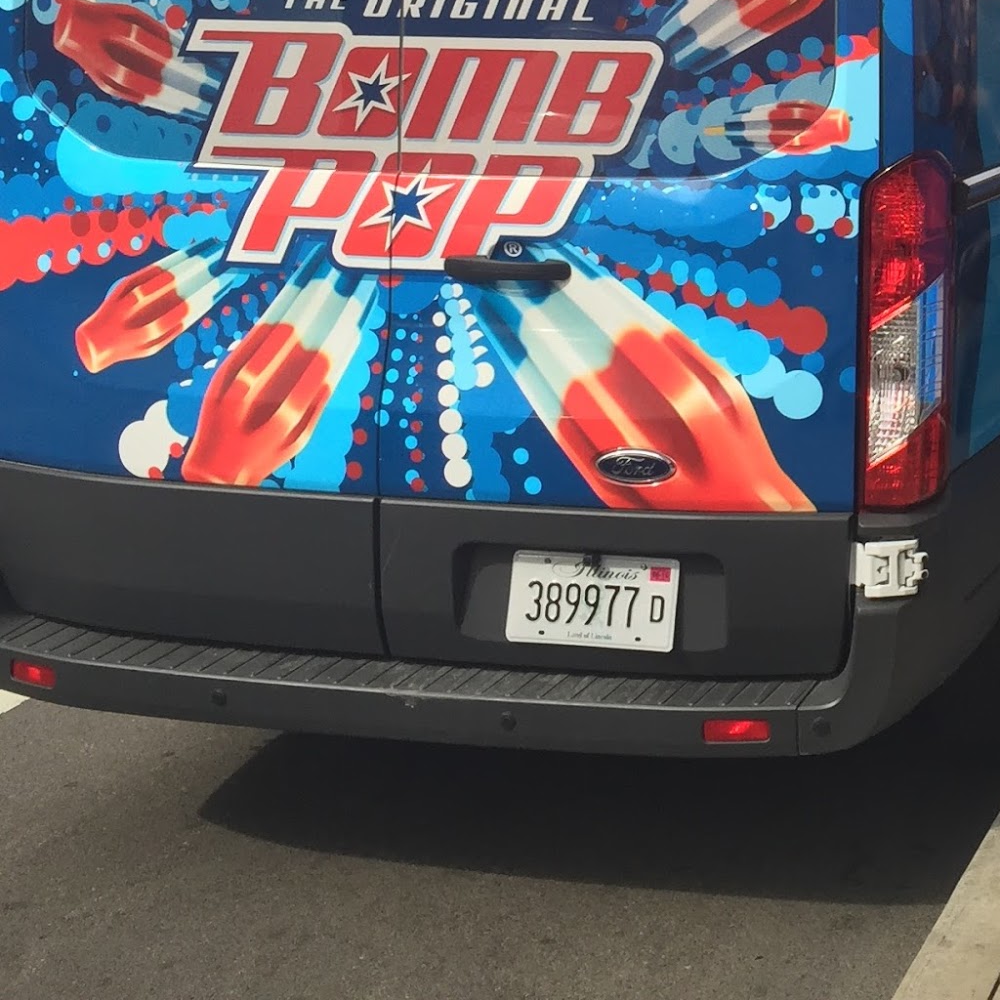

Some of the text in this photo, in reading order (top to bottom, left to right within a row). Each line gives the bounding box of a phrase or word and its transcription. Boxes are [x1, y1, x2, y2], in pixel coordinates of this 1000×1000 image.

[196, 26, 657, 148] BOMB
[208, 144, 586, 262] POP
[611, 456, 656, 476] Ford
[552, 561, 641, 581] Illinois
[525, 580, 665, 628] 389977 D
